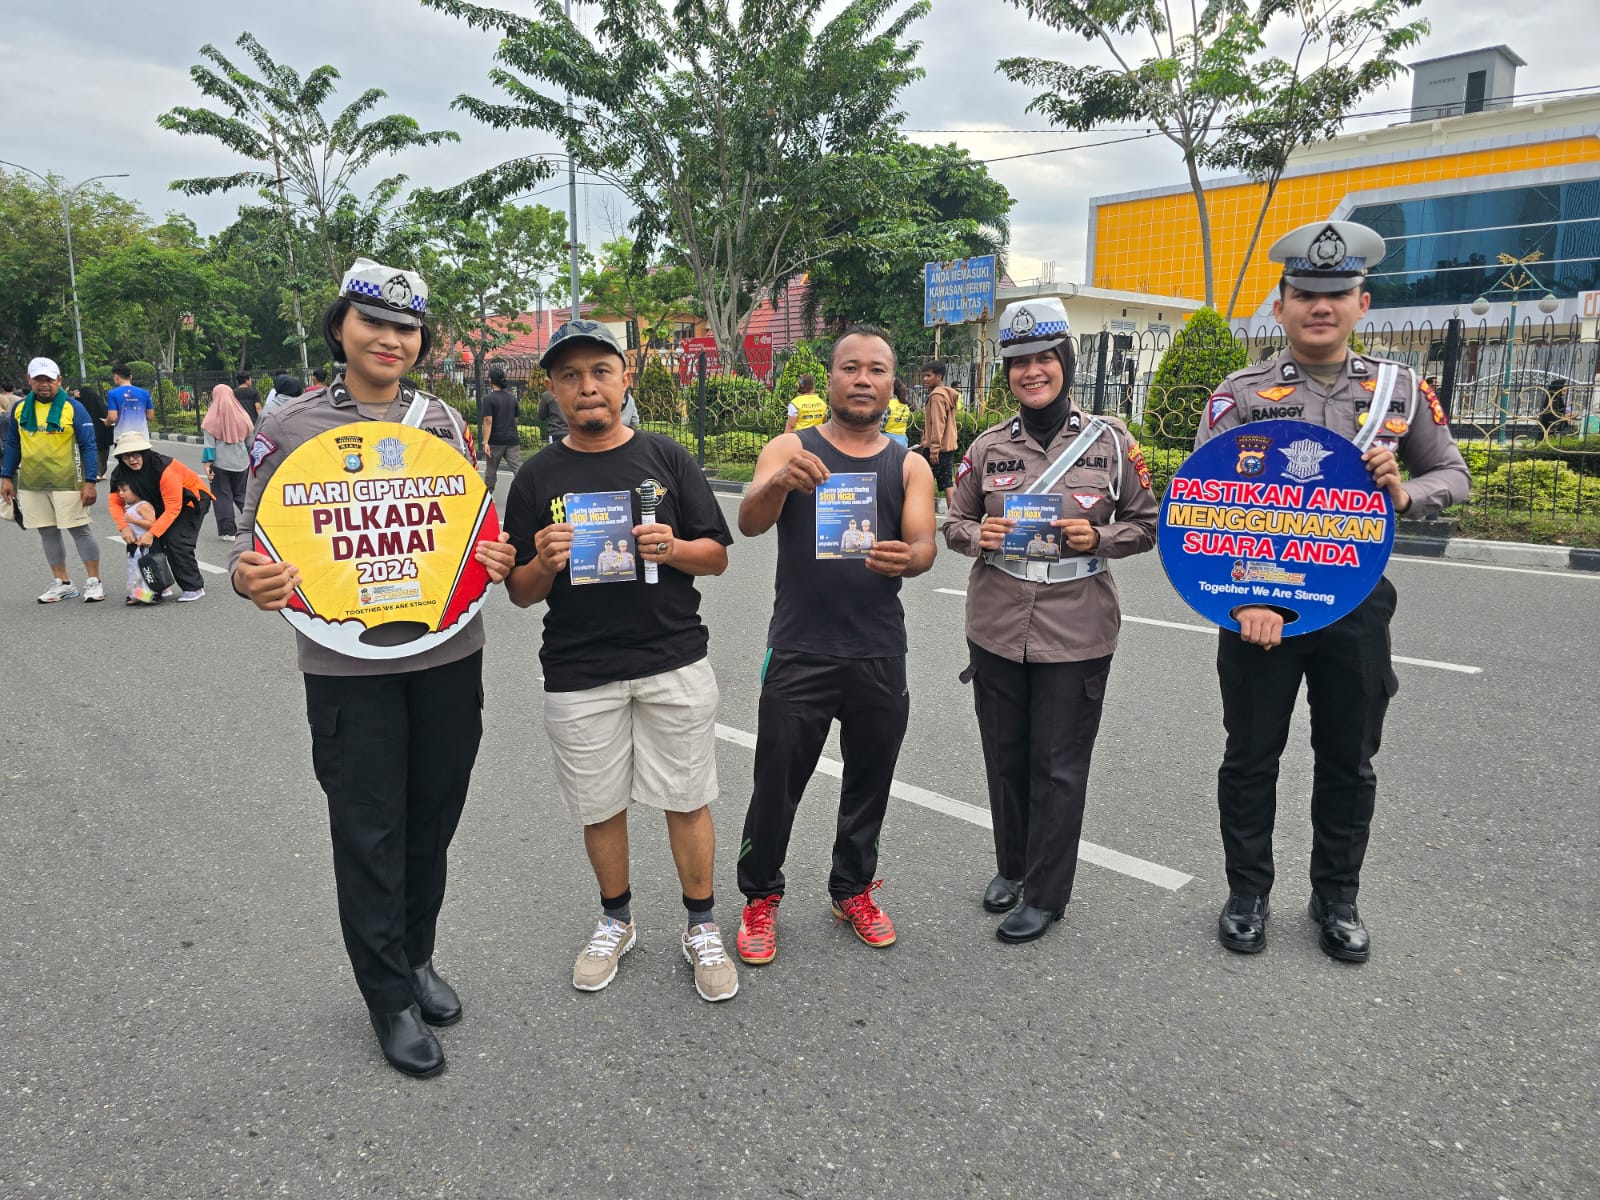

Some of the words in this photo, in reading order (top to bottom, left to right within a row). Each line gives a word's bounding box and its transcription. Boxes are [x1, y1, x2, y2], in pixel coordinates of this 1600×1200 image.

[931, 270, 950, 283] ANDA
[952, 266, 989, 282] MEMASUKI
[929, 284, 963, 298] KAWASAN
[937, 300, 954, 312] LALU
[956, 298, 982, 310] LINTAS
[1252, 406, 1304, 421] RANGGY
[987, 459, 1025, 474] ROZA
[283, 481, 349, 506] MARI
[353, 475, 466, 502] CIPTAKAN
[1171, 478, 1304, 509] PASTIKAN
[1307, 487, 1387, 514] ANDA
[312, 501, 447, 534] PILKADA
[1167, 503, 1386, 542] MENGGUNAKAN
[331, 528, 435, 561] DAMAI
[1183, 531, 1275, 559] SUARA
[1281, 539, 1360, 567] ANDA
[356, 558, 419, 584] 2024
[1198, 581, 1249, 595] Together
[1252, 585, 1270, 596] We
[1273, 587, 1292, 599] Are
[1294, 589, 1335, 605] Strong
[345, 606, 381, 616] TOGETHER
[383, 604, 394, 612] WE
[410, 600, 437, 609] STRONG
